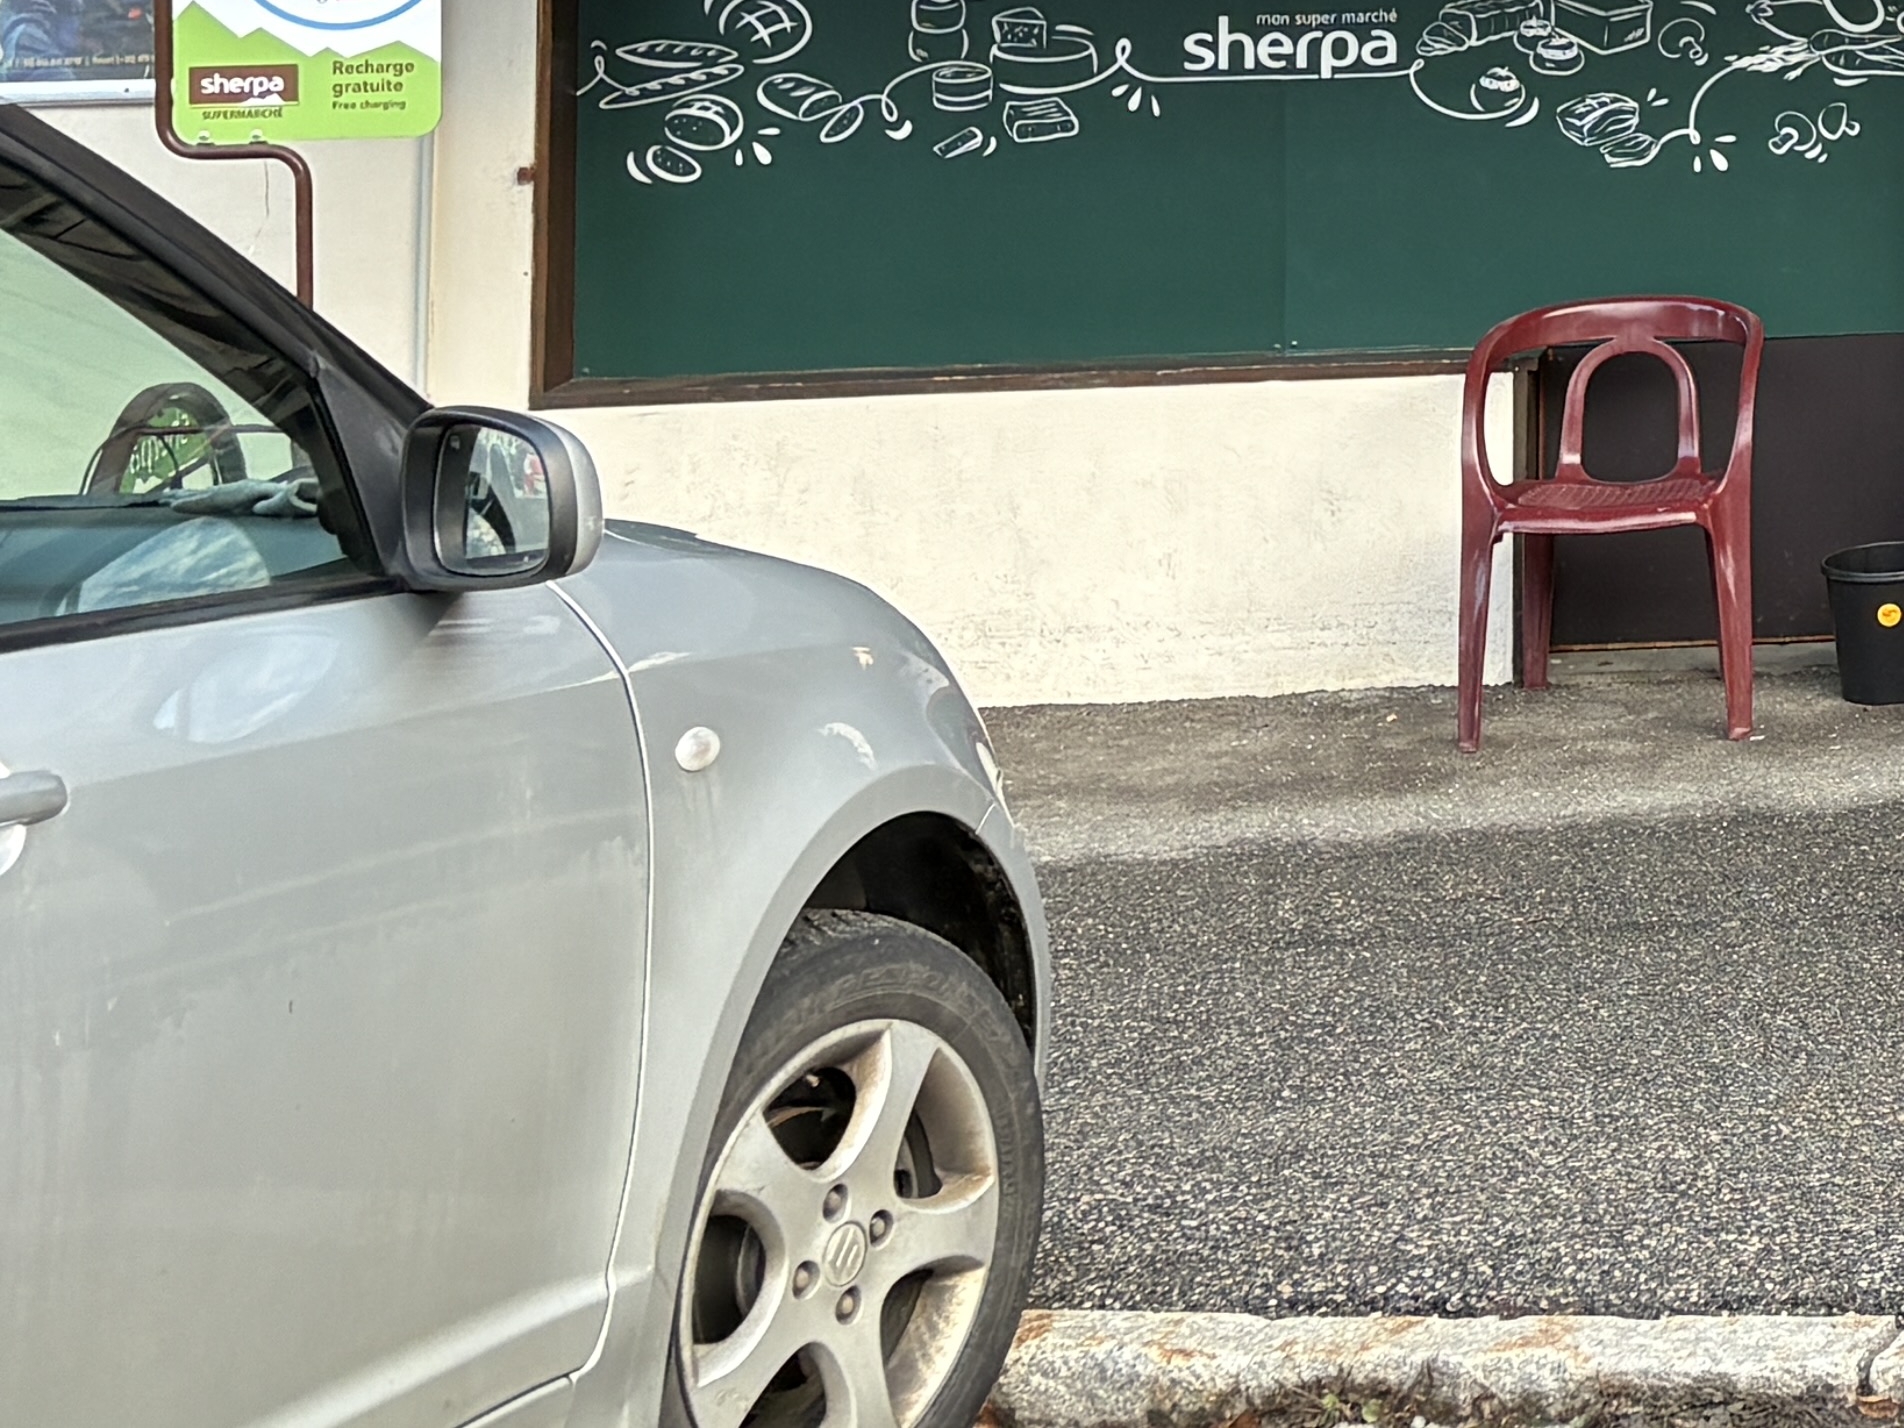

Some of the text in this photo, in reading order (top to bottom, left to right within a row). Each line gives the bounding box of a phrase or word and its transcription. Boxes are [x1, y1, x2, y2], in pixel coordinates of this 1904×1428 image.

[1256, 7, 1398, 28] mon super marché
[1183, 15, 1398, 79] sherpa
[331, 59, 415, 79] Recharge
[200, 72, 285, 96] sherpa
[331, 78, 405, 98] gratuite
[331, 98, 407, 111] Free charging
